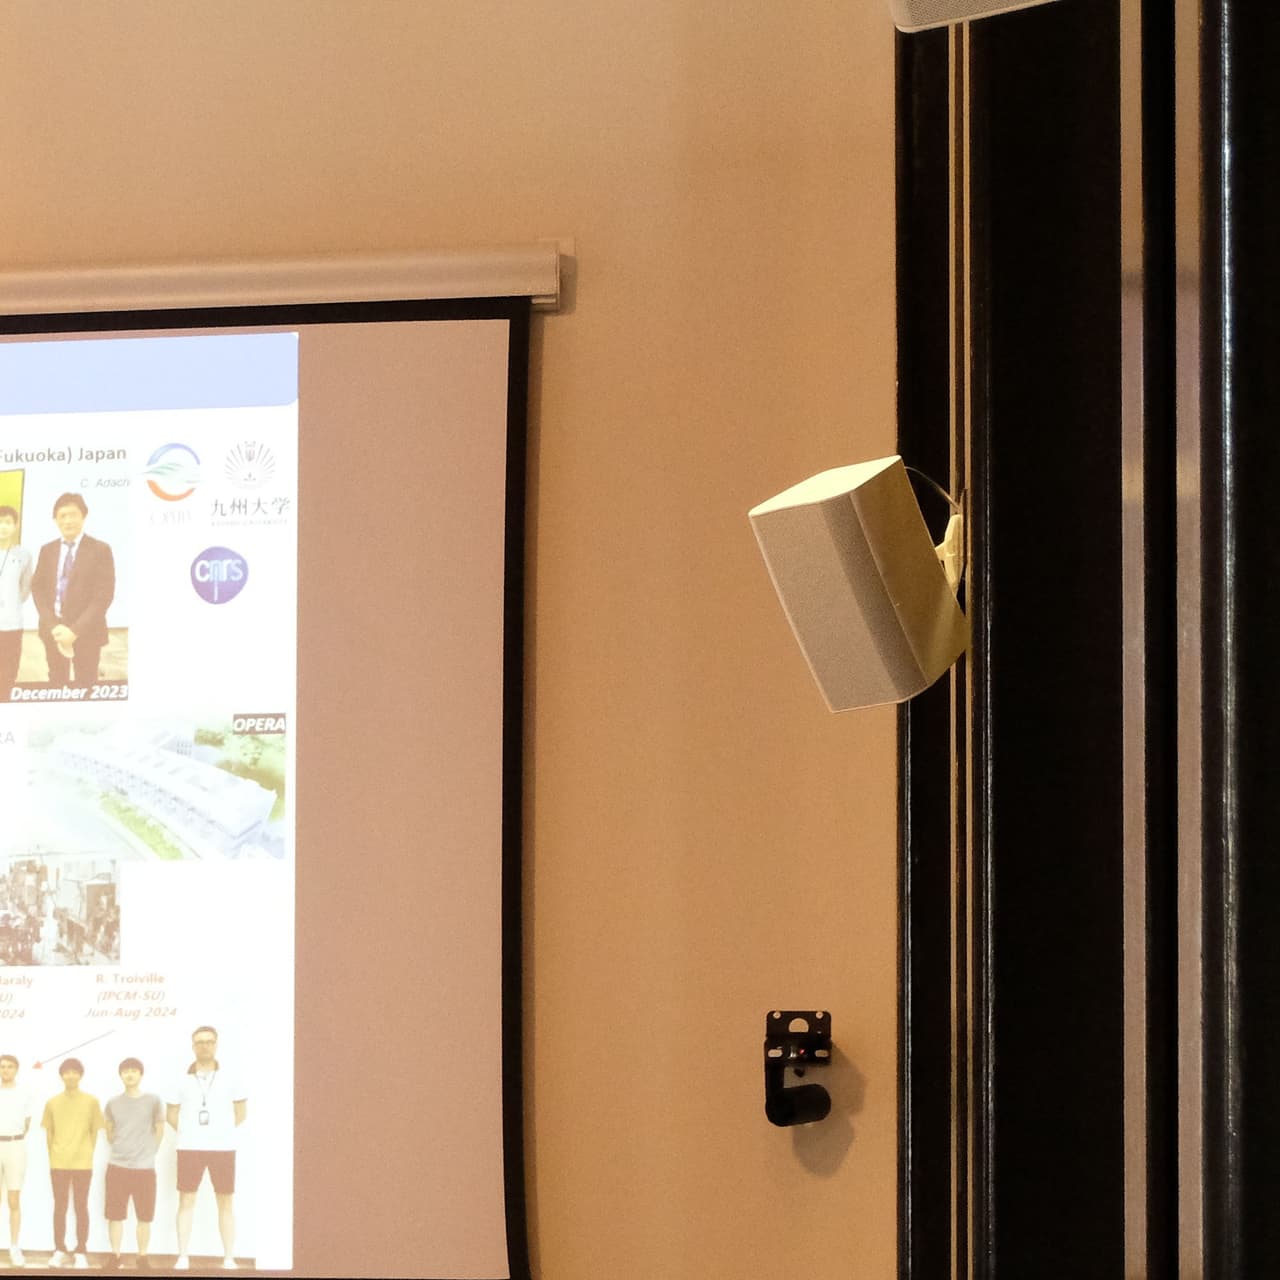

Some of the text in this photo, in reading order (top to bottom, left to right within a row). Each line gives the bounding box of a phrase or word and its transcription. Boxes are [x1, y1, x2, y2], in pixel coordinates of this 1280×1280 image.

[77, 446, 128, 464] Japan
[10, 684, 128, 701] December 2023
[233, 717, 286, 732] OPERA
[144, 1007, 178, 1019] 2024
